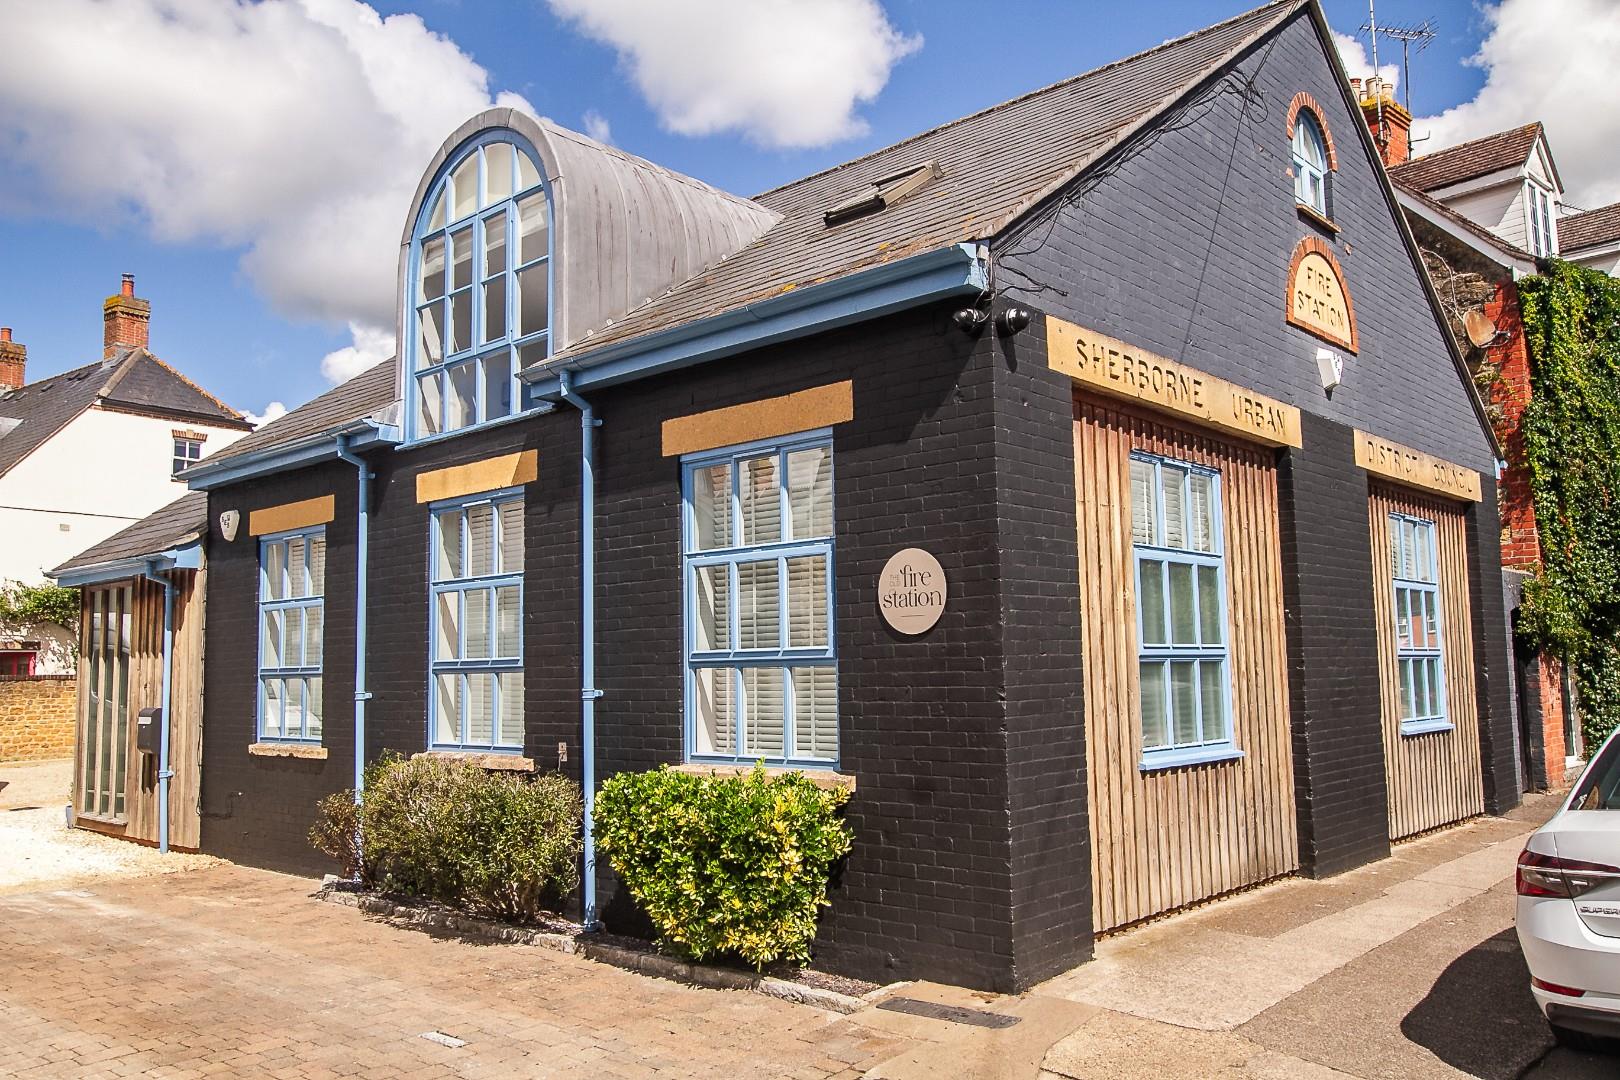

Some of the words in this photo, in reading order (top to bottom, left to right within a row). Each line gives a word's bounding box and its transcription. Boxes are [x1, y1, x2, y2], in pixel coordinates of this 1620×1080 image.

[1307, 266, 1332, 298] FIRE
[1297, 290, 1345, 332] STATION
[1076, 338, 1204, 409] SHERBORNE
[1232, 392, 1287, 436] URBAN
[1367, 440, 1418, 478] DISTRICT
[1433, 463, 1473, 493] COUNCIL
[899, 564, 932, 588] fire
[882, 588, 943, 609] station
[1580, 906, 1620, 915] SUPER
